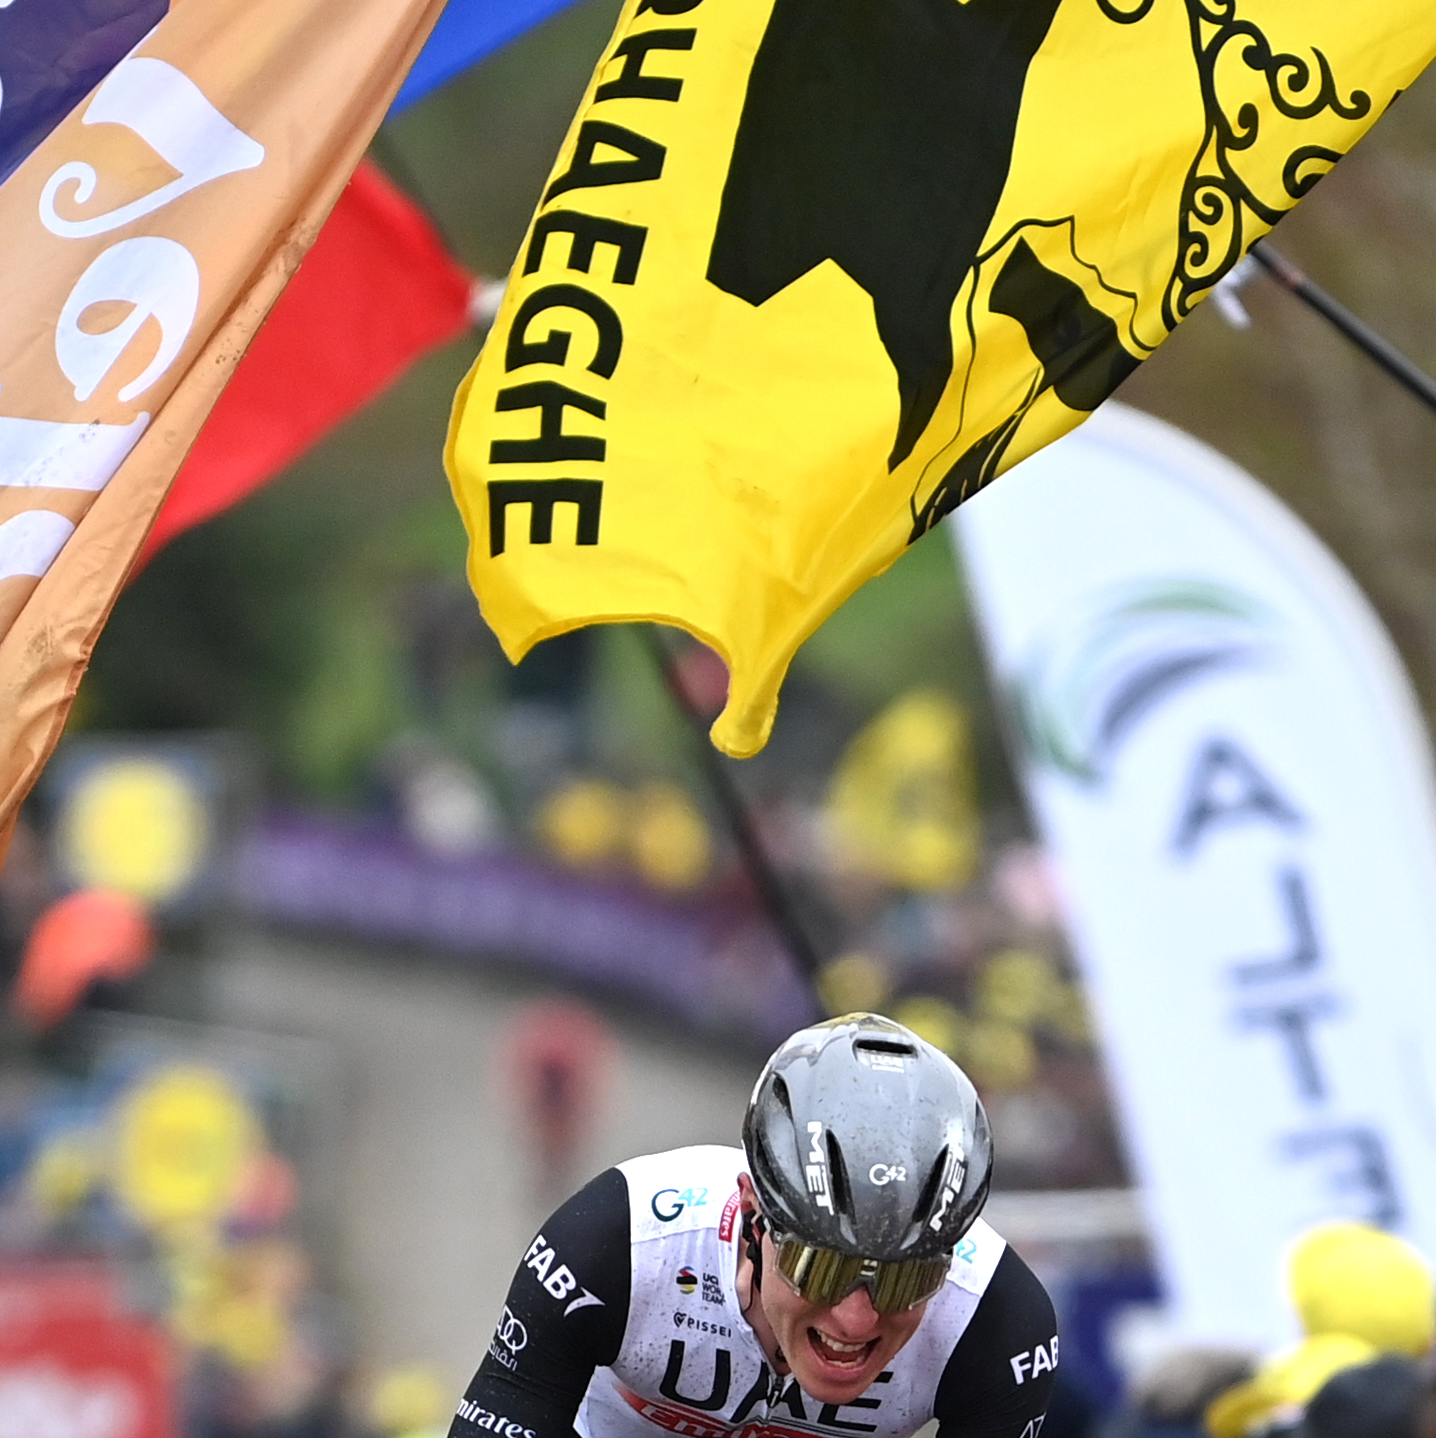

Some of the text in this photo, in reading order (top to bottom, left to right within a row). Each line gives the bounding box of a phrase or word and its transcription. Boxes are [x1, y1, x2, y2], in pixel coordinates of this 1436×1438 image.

[488, 0, 703, 558] HAEGHE
[805, 1121, 834, 1215] MET
[869, 1163, 906, 1186] G42
[651, 1187, 708, 1222] G42
[524, 1234, 578, 1300] FAB
[496, 1304, 528, 1355] DQ
[687, 1317, 732, 1338] PISSEI
[659, 1339, 894, 1432] UAE
